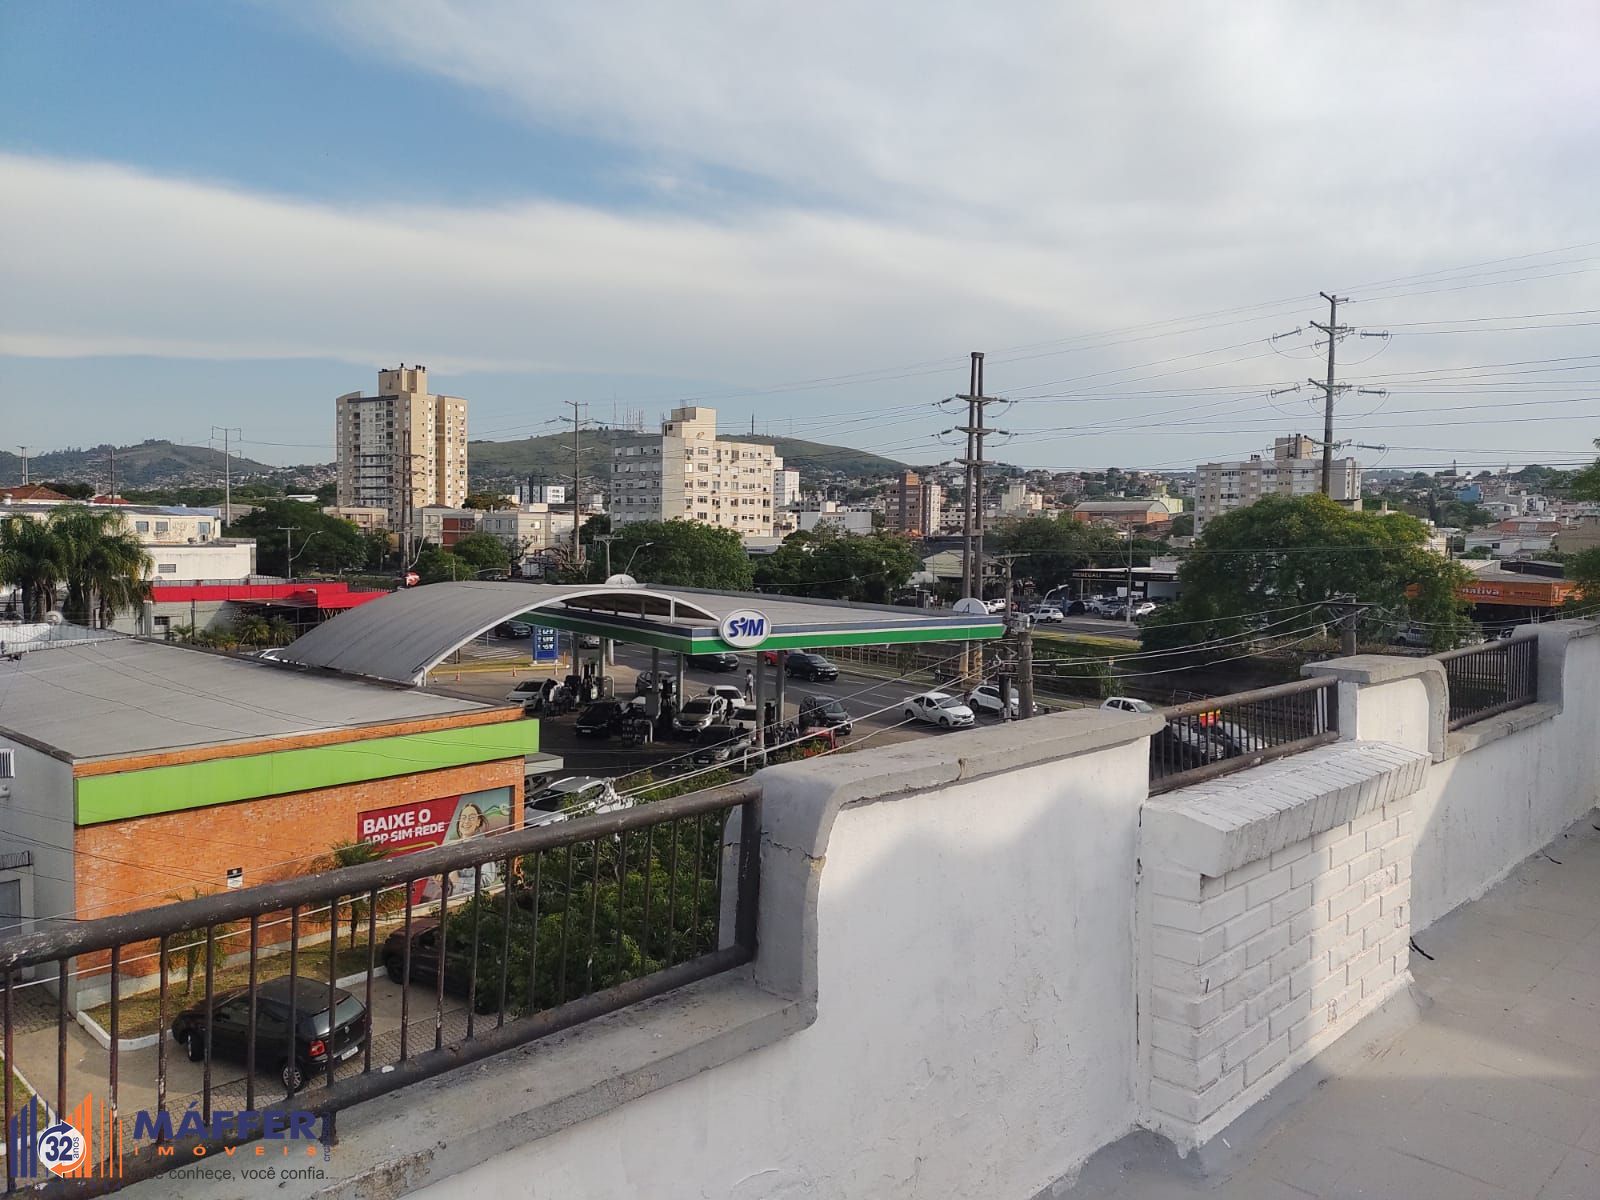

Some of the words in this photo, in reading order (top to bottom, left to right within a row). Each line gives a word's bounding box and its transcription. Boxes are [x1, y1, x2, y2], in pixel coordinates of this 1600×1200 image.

[728, 617, 764, 638] SIM
[363, 811, 415, 834] BAIXE
[418, 808, 431, 823] O
[364, 833, 389, 845] APP
[391, 828, 413, 841] SIM
[414, 822, 445, 838] REDE
